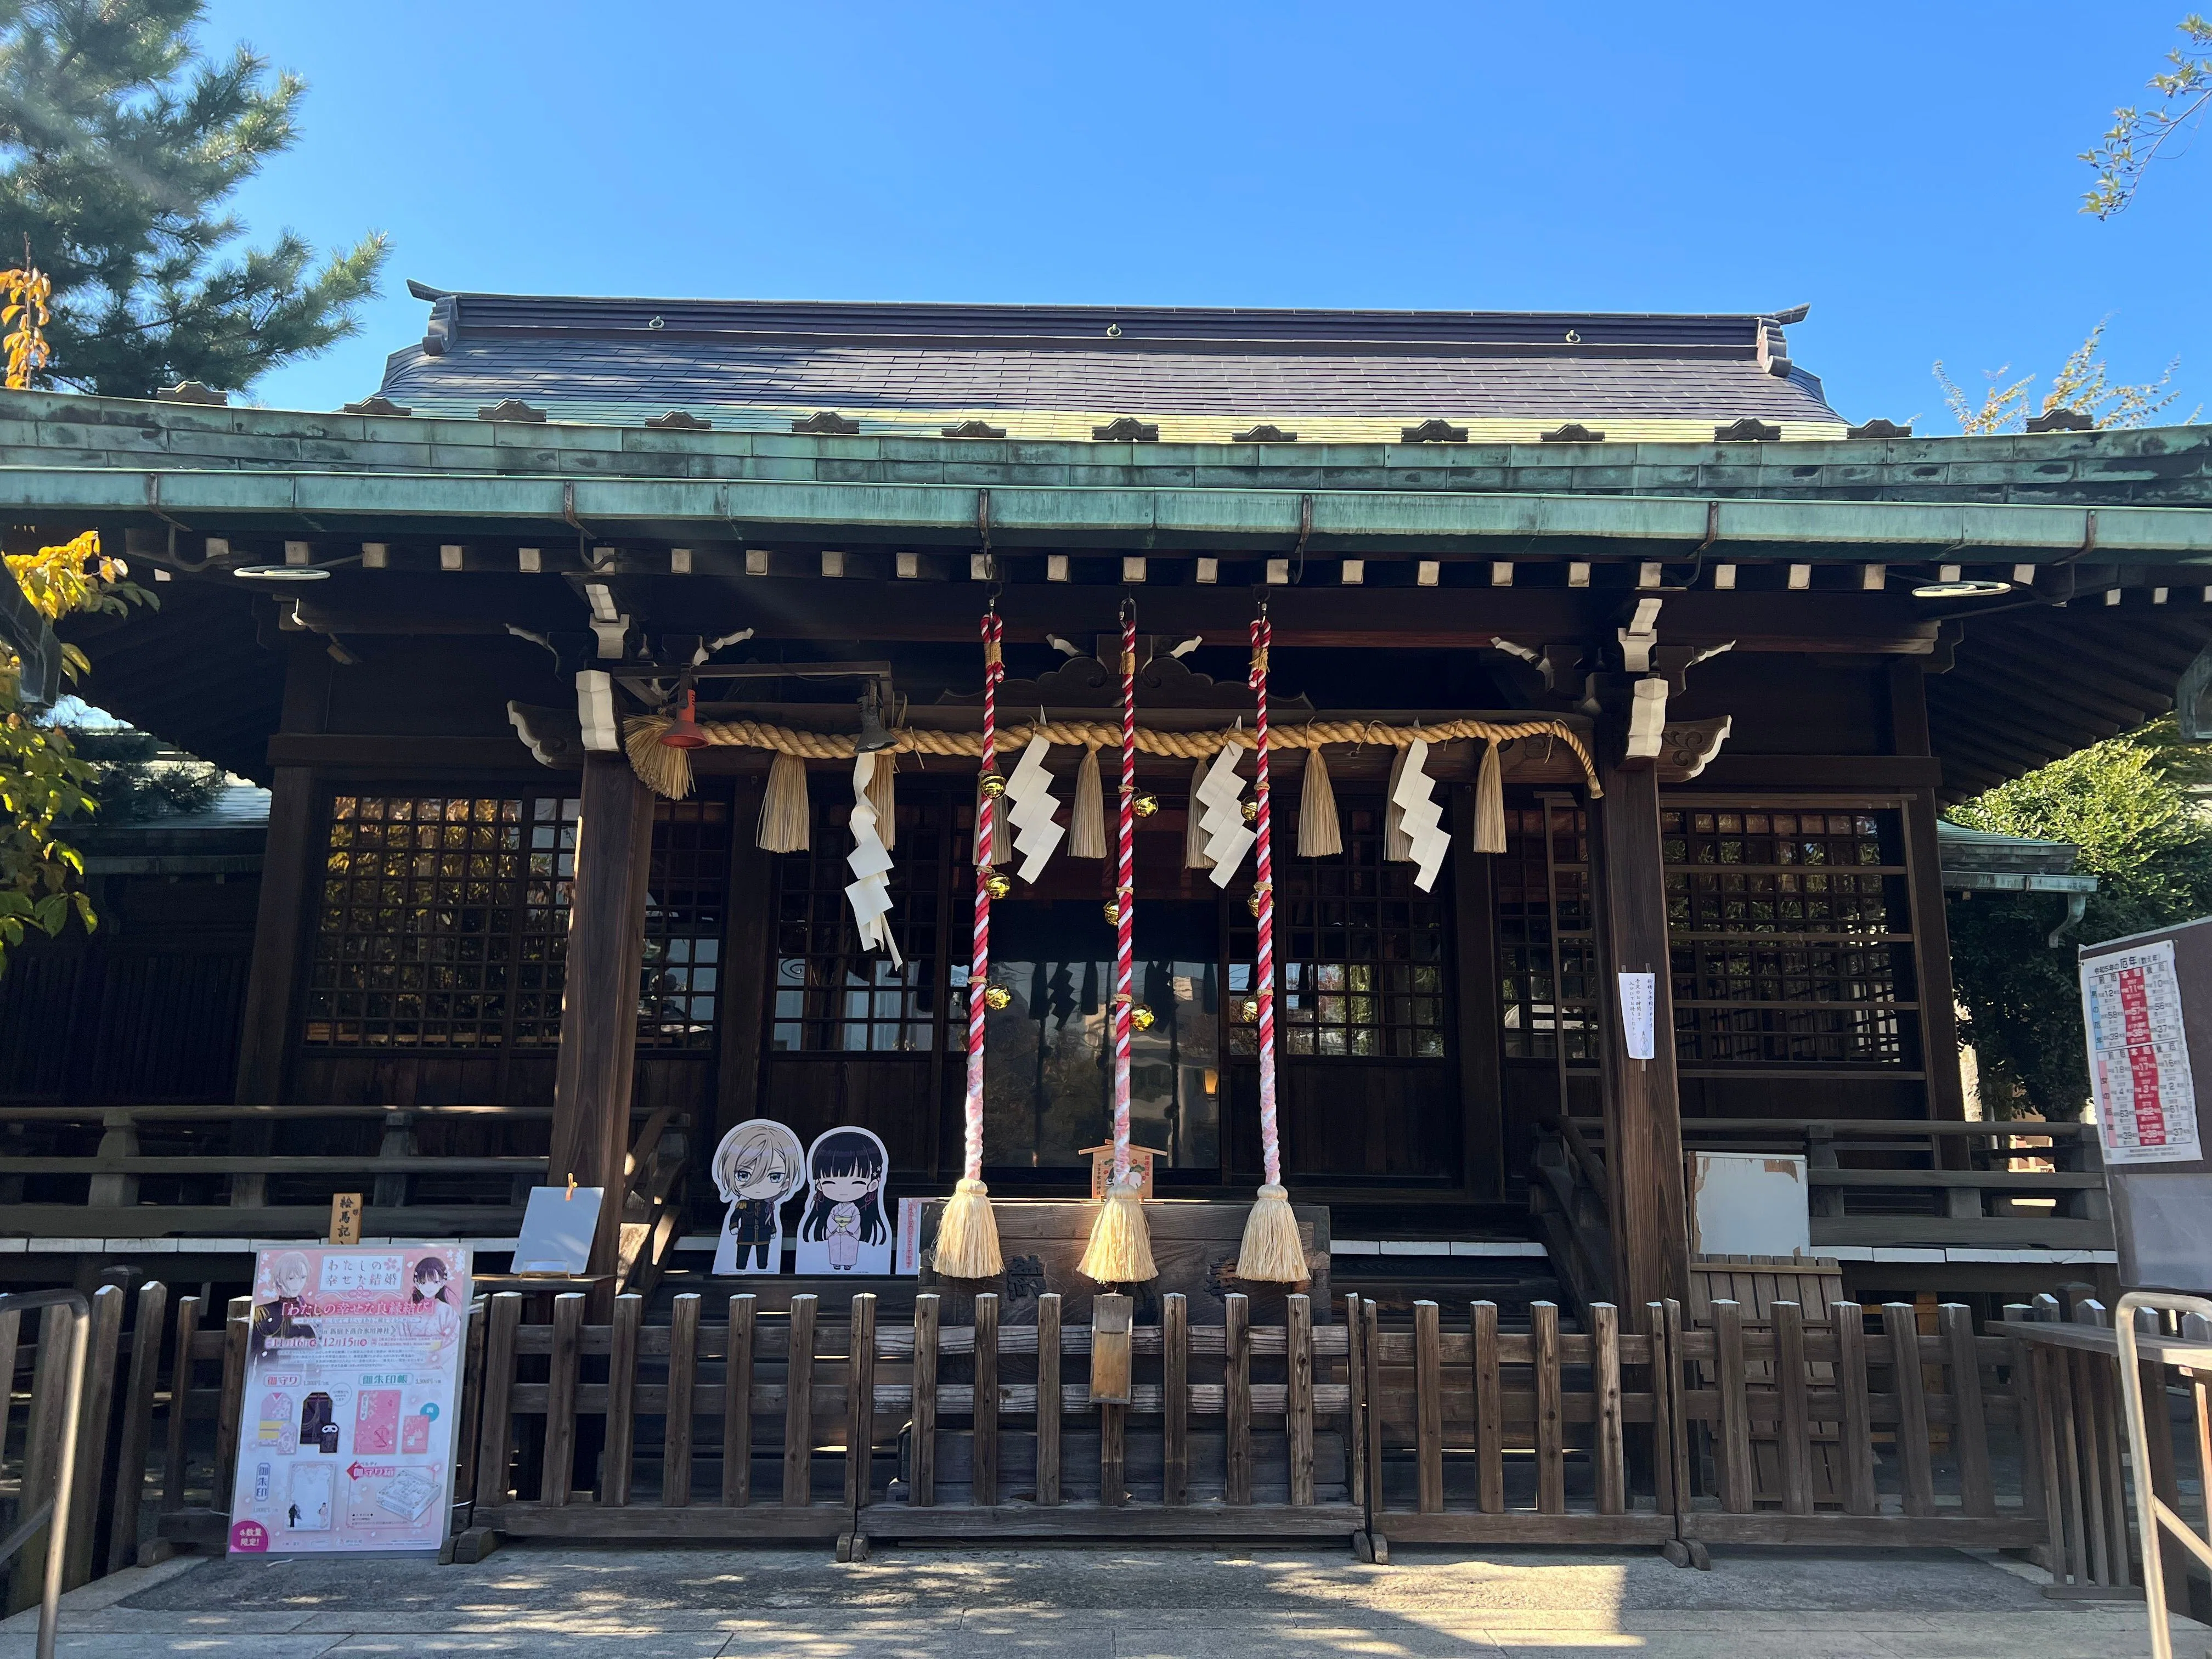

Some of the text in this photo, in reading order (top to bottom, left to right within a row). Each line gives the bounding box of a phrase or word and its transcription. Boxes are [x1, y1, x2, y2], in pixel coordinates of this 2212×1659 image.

[337, 1196, 354, 1244] 絵馬記
[328, 1260, 381, 1271] わたしの
[325, 1273, 397, 1286] 幸せな結婚
